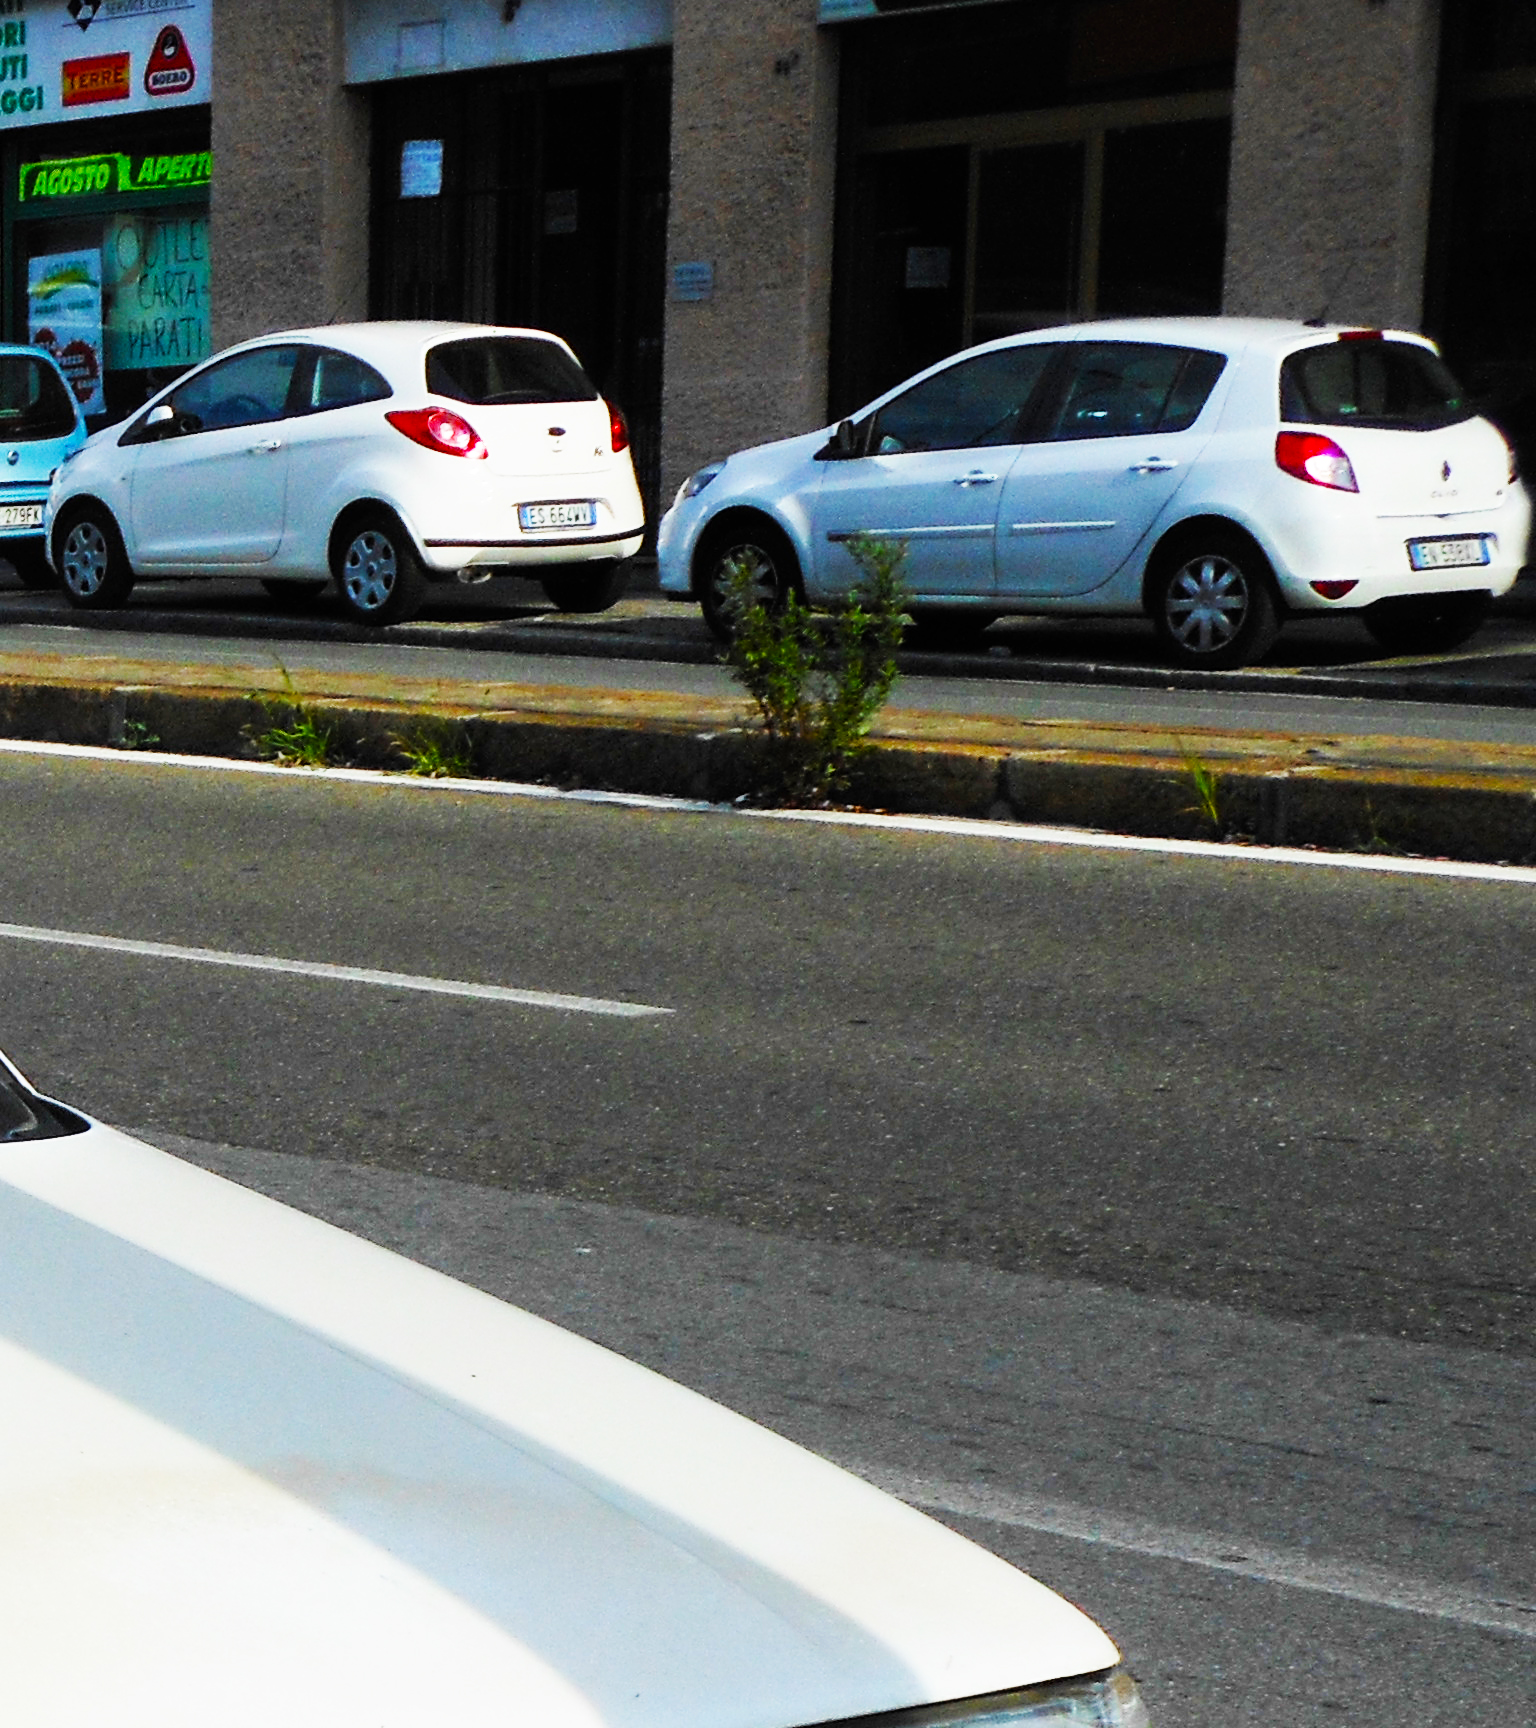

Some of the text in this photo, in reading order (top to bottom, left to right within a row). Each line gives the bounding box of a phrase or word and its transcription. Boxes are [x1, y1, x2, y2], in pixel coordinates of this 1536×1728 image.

[68, 68, 125, 91] TERRE
[152, 70, 187, 87] BOERO
[32, 163, 110, 196] AGOSTO
[116, 218, 209, 270] OUTLE
[129, 316, 203, 360] PARATI
[5, 507, 40, 523] 279FK
[529, 507, 545, 525] ES
